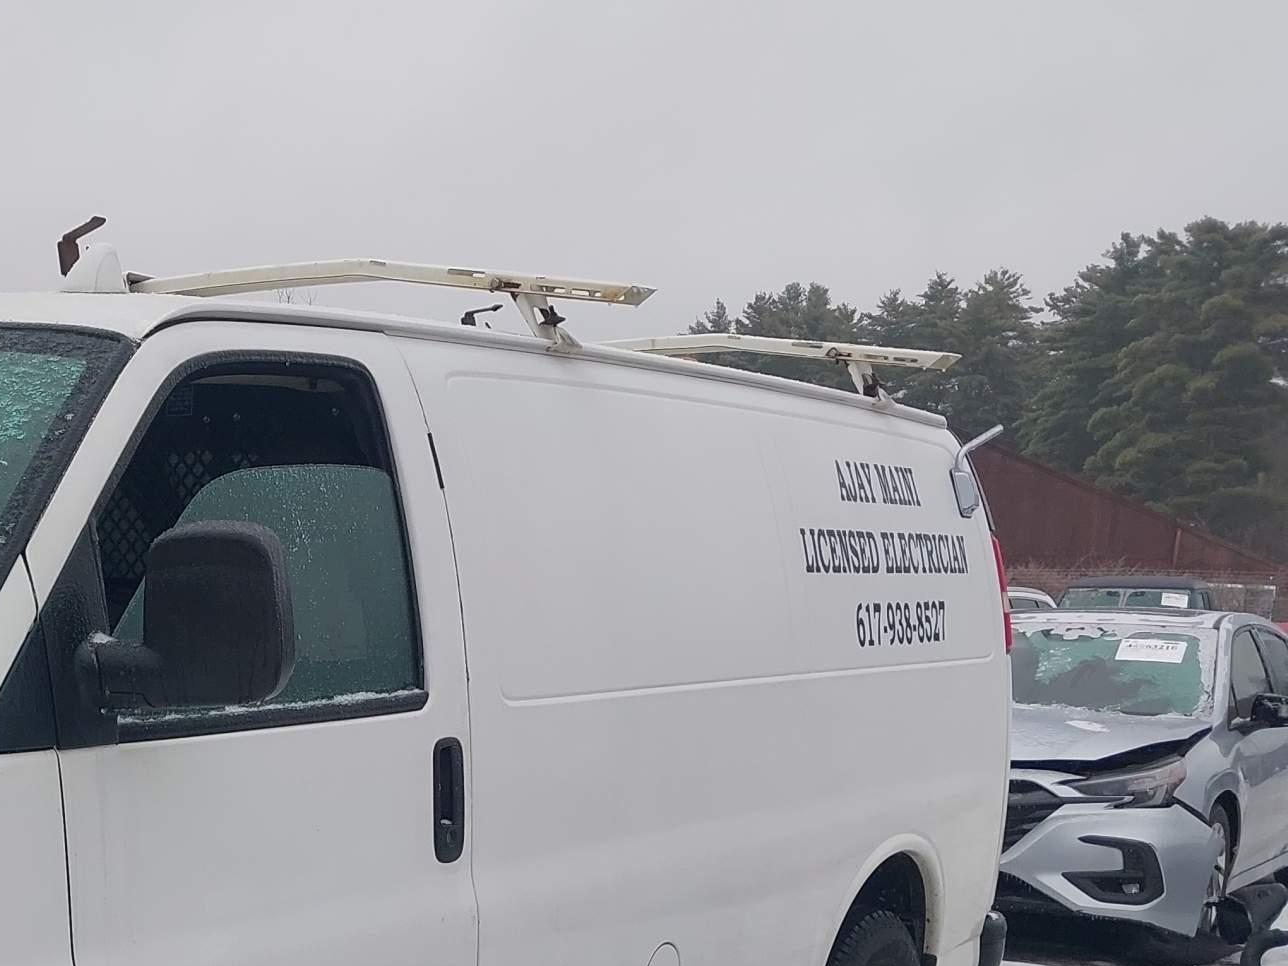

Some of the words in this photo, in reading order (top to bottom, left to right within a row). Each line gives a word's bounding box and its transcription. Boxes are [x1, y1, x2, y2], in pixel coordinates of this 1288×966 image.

[834, 459, 876, 504] AJAY
[799, 528, 880, 574] LICENSED
[880, 531, 969, 575] ELECTRICIAN
[855, 600, 946, 648] 617-938-8527
